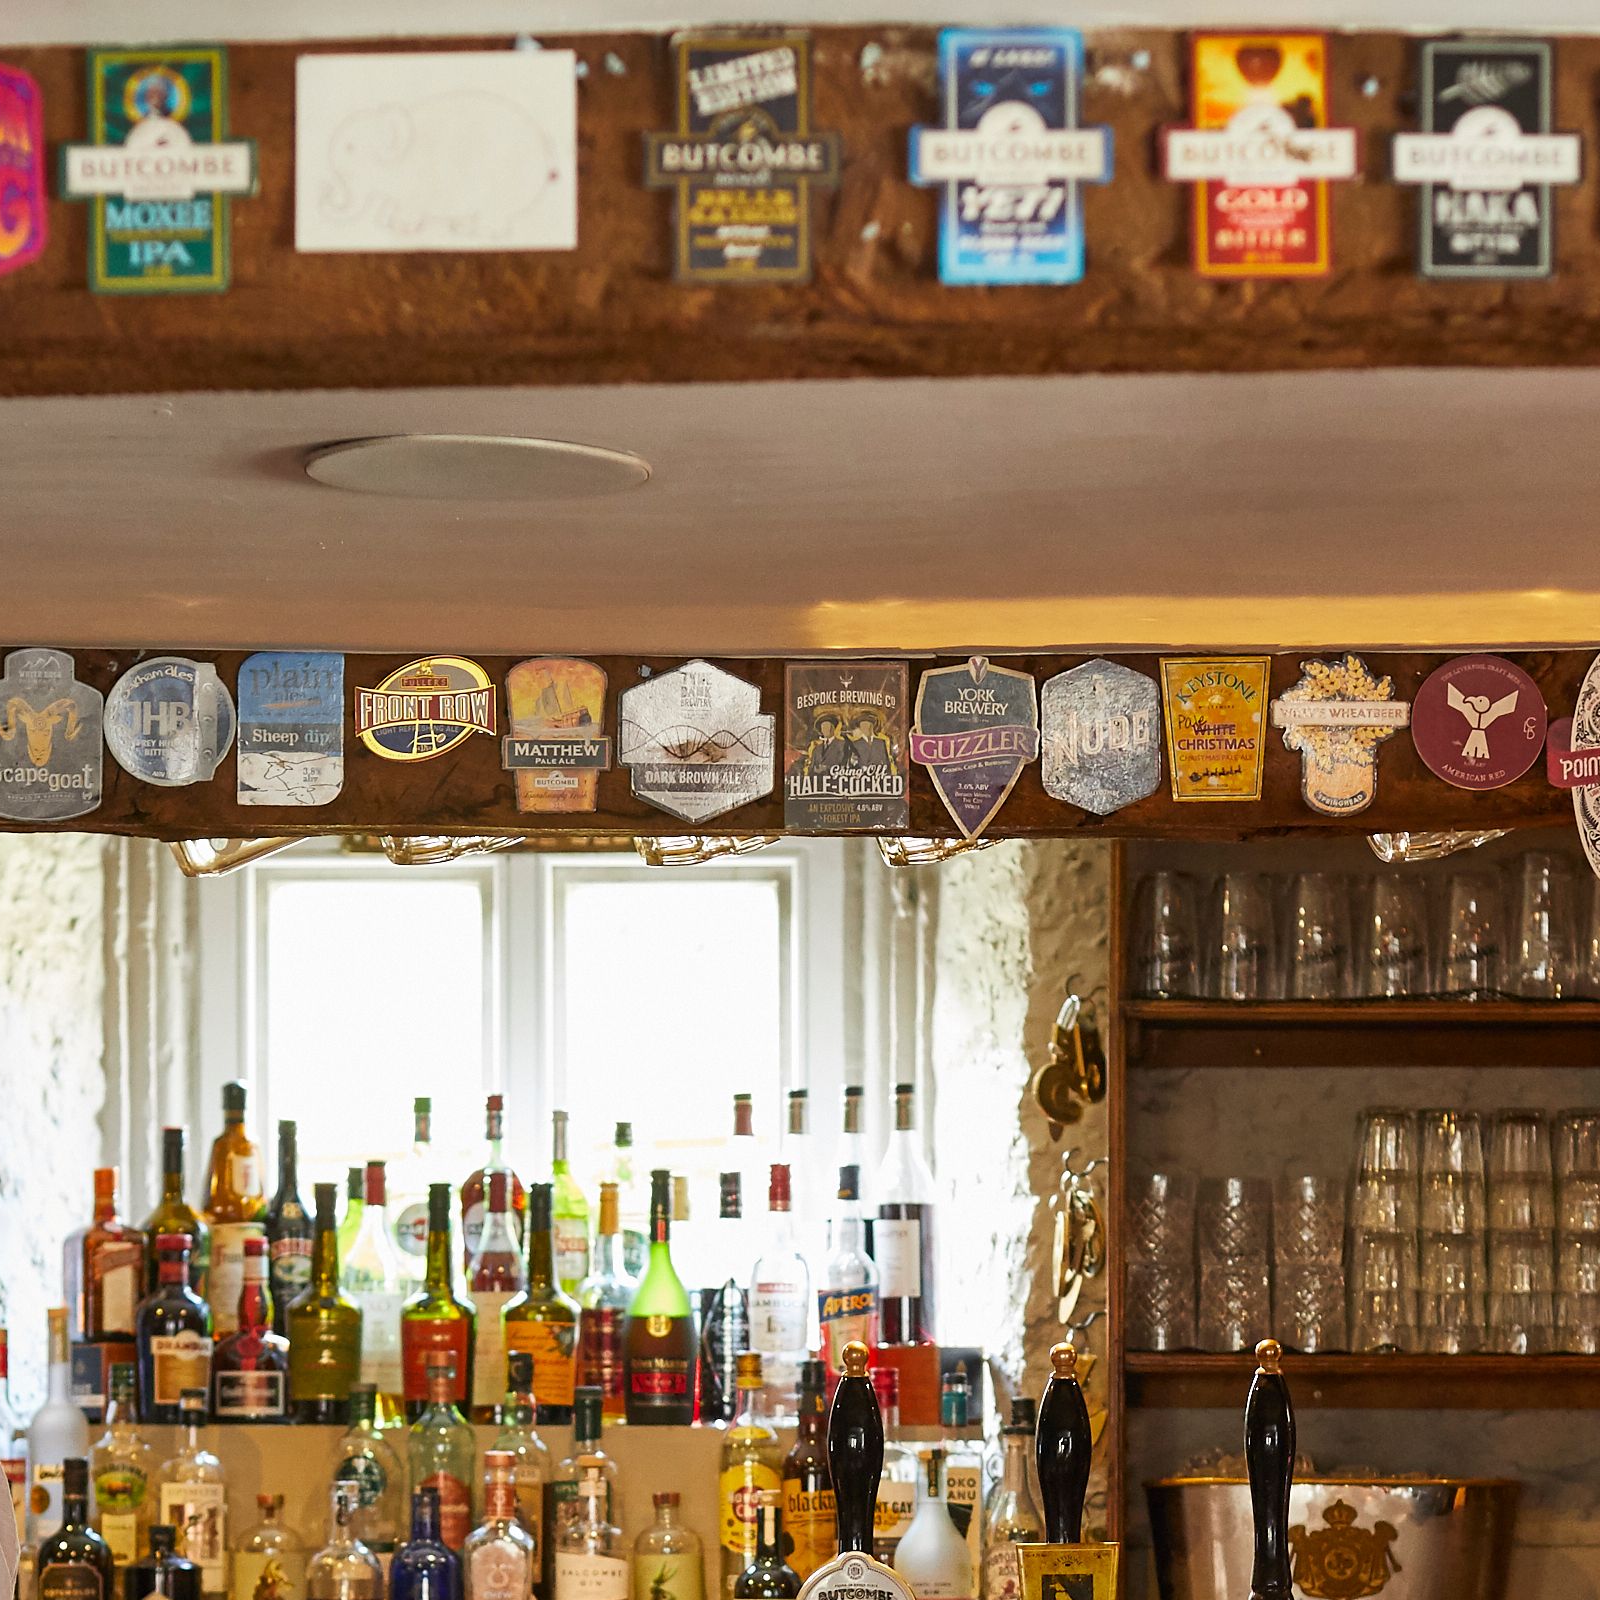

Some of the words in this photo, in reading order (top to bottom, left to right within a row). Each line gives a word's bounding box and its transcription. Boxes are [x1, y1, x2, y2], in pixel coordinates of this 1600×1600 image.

[80, 151, 239, 178] BUTCOMBE
[662, 144, 824, 171] BUTCOMBE
[128, 240, 192, 268] IPA
[249, 660, 335, 697] plain
[957, 688, 995, 702] YORK
[1175, 670, 1258, 705] KEYSTONE
[796, 690, 837, 709] BESPOKE
[839, 690, 882, 706] BREWING
[944, 700, 1009, 716] BREWERY
[360, 692, 432, 730] FRONT
[439, 691, 489, 728] ROW
[375, 727, 395, 736] LIGHT
[444, 725, 459, 733] ALE
[1178, 714, 1206, 730] Pale
[252, 728, 300, 746] Sheep
[1053, 705, 1154, 766] NUDE
[513, 742, 600, 757] MATTHEW
[919, 731, 1029, 760] GUZZLER
[1178, 739, 1256, 751] CHRISTMAS
[535, 757, 556, 765] PALE
[558, 757, 575, 765] ALE
[645, 771, 676, 785] DARK
[679, 770, 720, 785] BROWN
[721, 770, 742, 785] ALE
[829, 765, 866, 779] Going
[867, 764, 888, 778] Off
[1441, 763, 1486, 783] AMERICAN
[1488, 768, 1507, 781] RED
[823, 813, 849, 824] FOREST
[849, 814, 862, 824] IPA
[824, 1293, 874, 1316] APEROL
[946, 1476, 977, 1489] OKO
[946, 1489, 977, 1501] ANU
